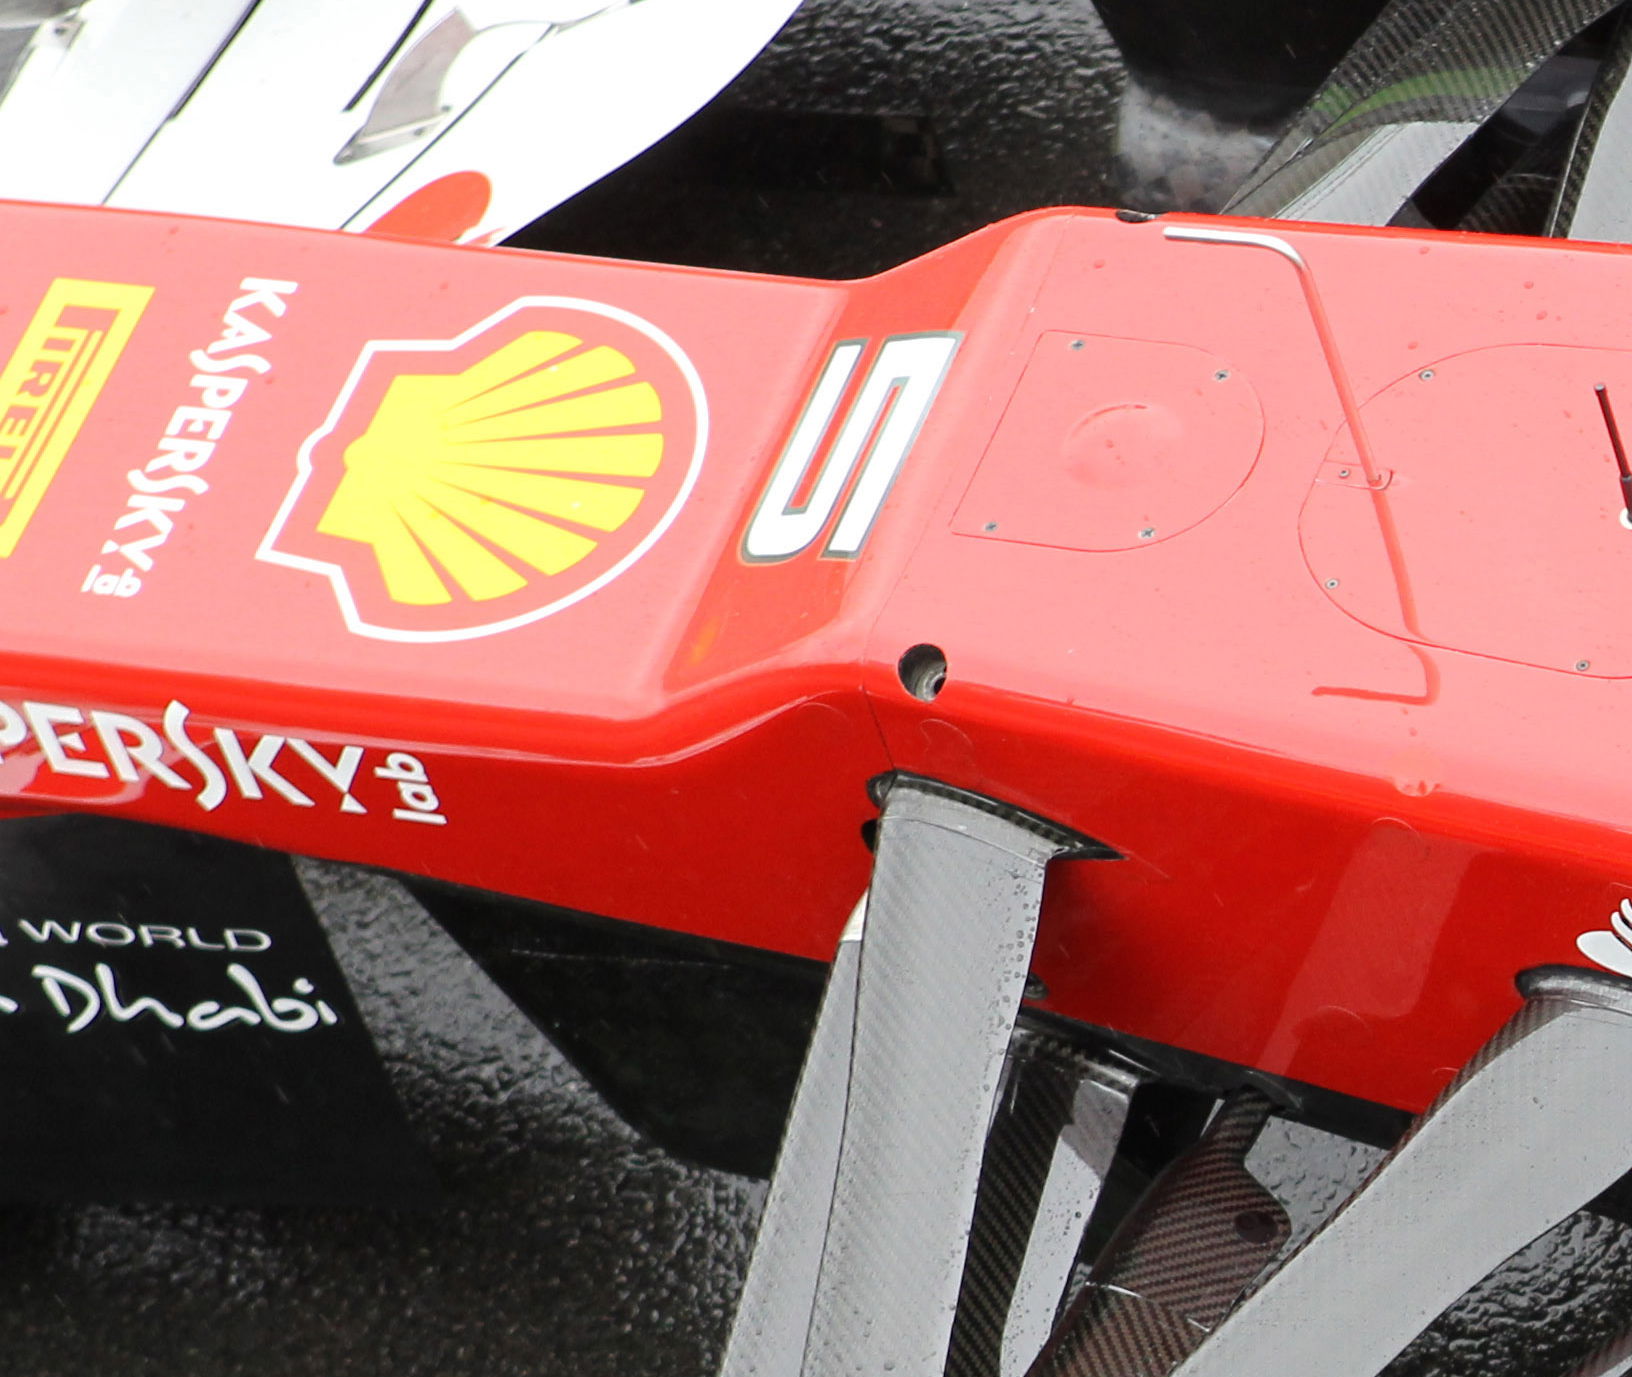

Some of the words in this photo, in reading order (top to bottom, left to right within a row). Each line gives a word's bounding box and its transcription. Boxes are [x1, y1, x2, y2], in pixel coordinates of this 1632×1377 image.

[101, 276, 298, 572] KASPERSKY
[738, 330, 966, 565] 5
[80, 564, 142, 598] lab
[374, 752, 448, 825] lab
[18, 918, 273, 952] WORLD
[31, 961, 339, 1034] Dhabi
